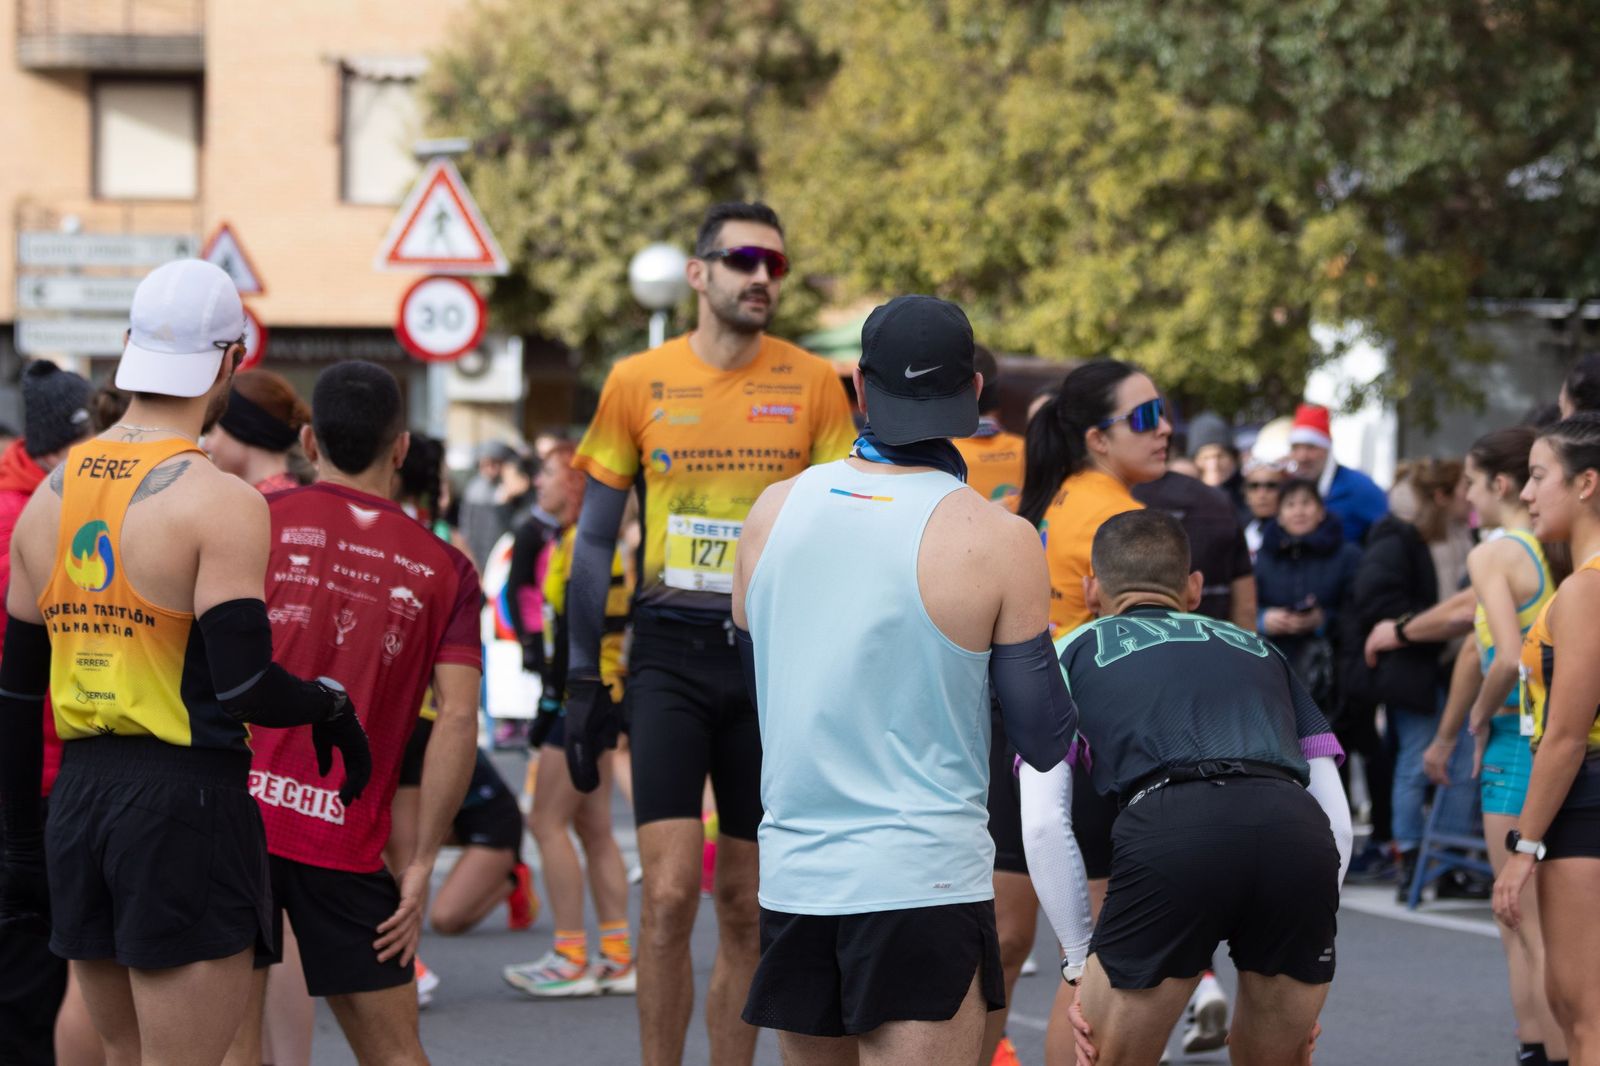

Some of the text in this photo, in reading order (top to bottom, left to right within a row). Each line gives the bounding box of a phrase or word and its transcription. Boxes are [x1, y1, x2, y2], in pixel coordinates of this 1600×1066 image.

[418, 304, 466, 332] 30
[673, 449, 732, 458] ESCUELA
[77, 454, 140, 480] PÉREZ
[686, 463, 784, 472] SALMANTINA
[690, 538, 729, 568] 127
[333, 563, 380, 584] ZURICH
